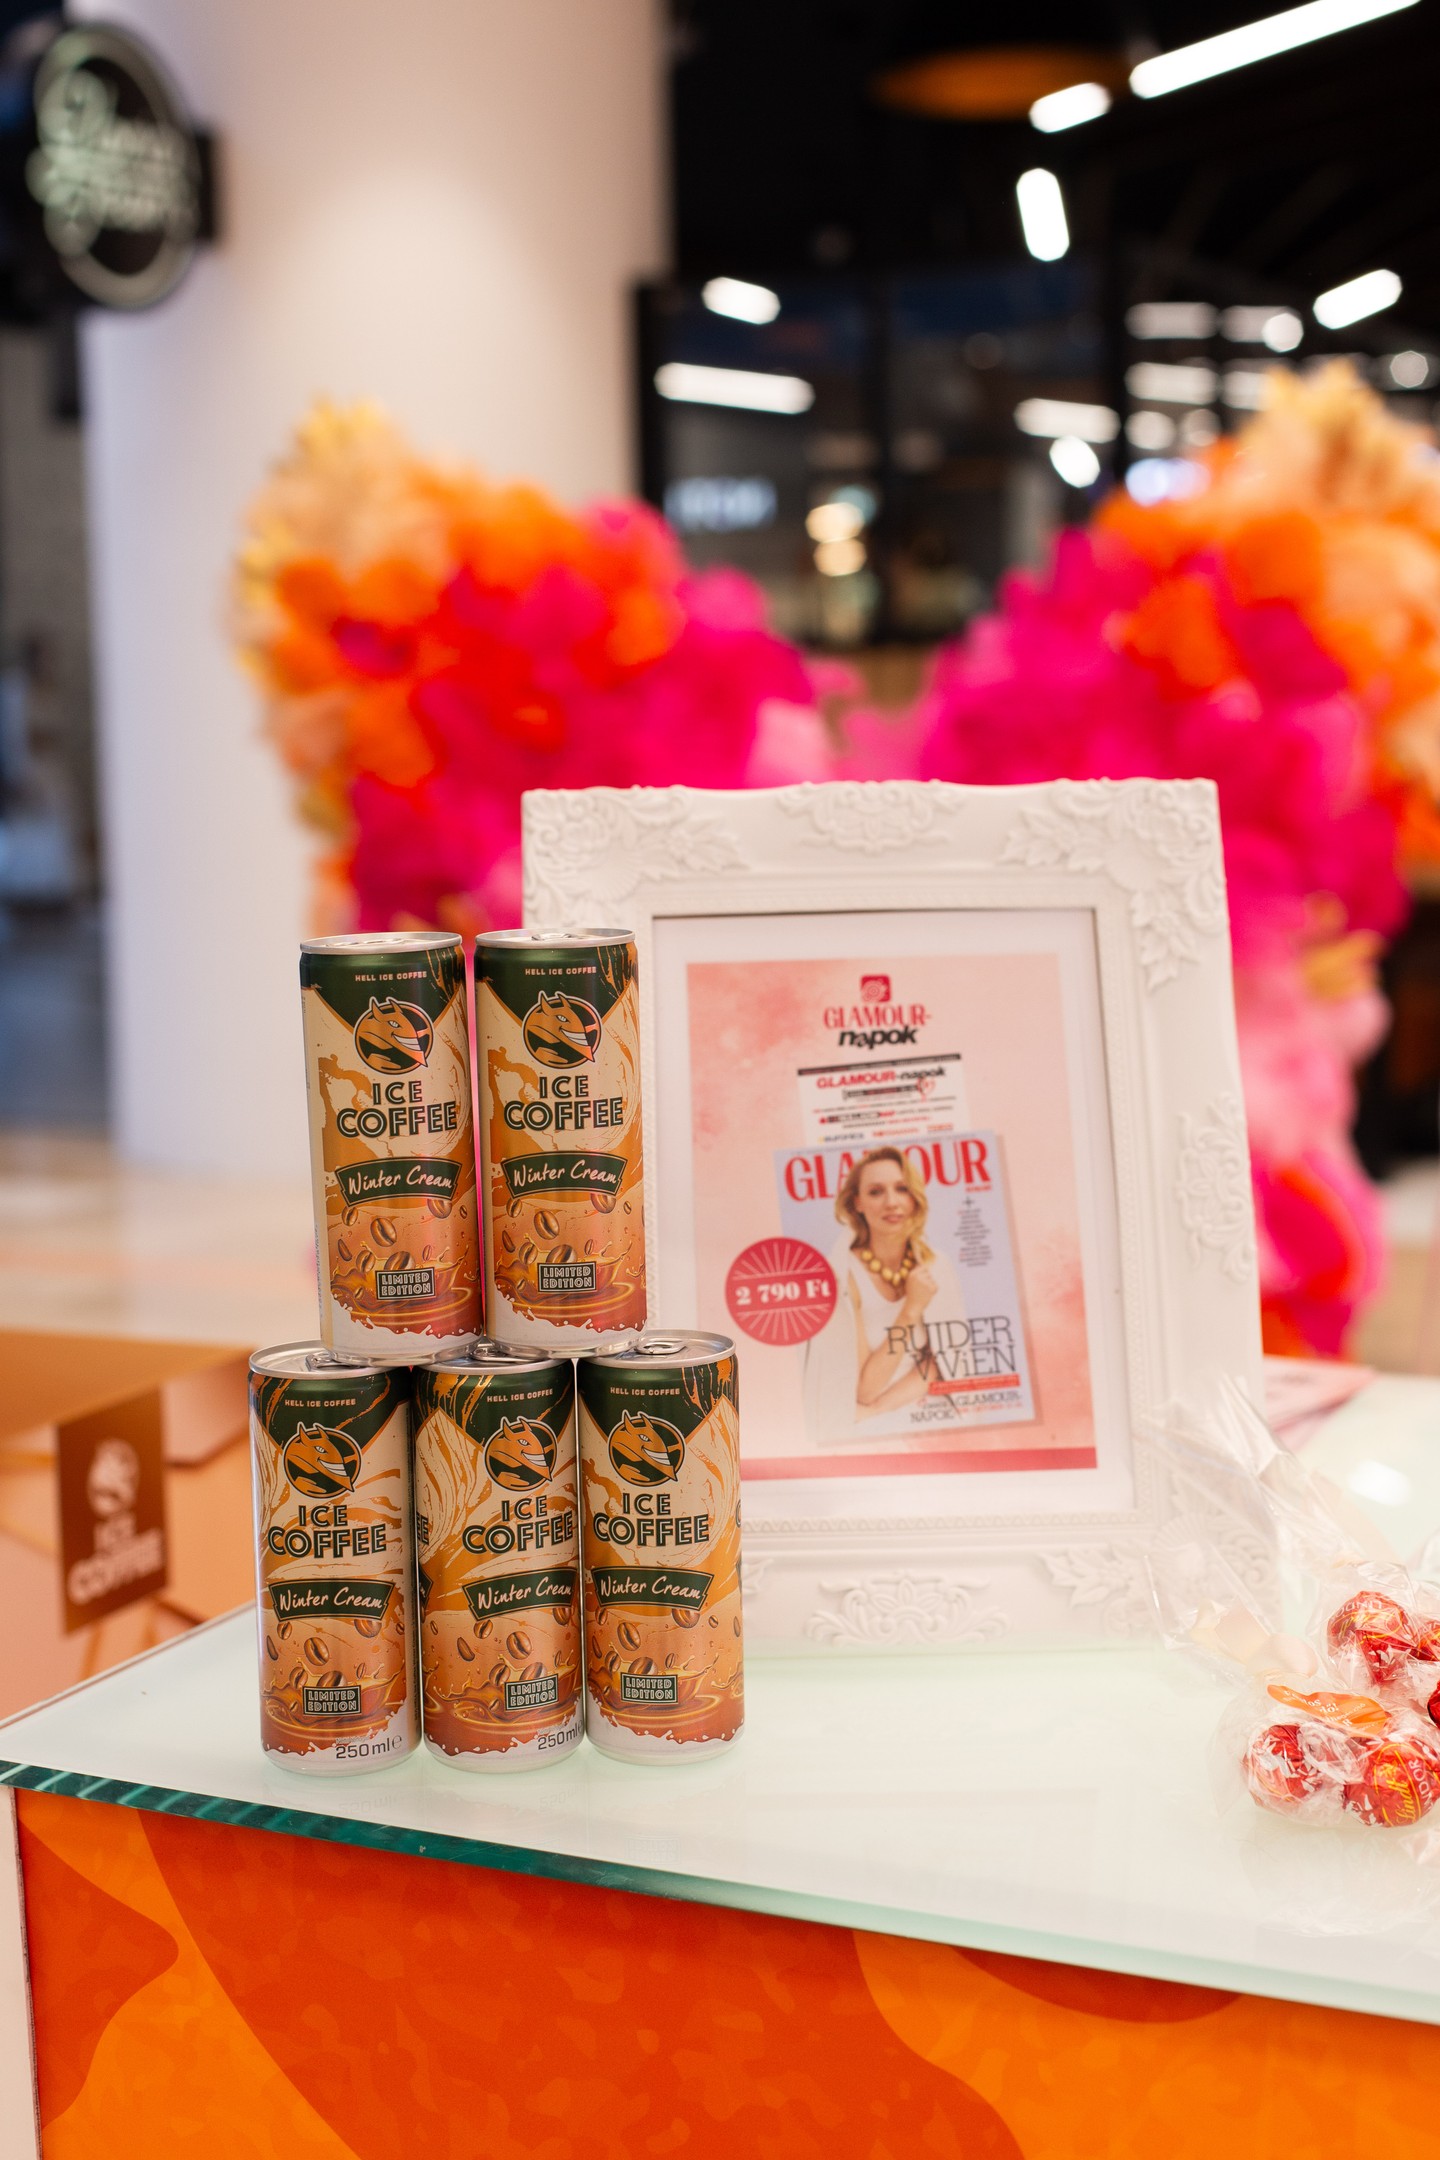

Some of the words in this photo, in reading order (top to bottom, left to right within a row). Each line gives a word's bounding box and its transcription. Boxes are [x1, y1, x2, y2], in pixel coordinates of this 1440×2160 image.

[355, 974, 376, 982] HELL
[379, 973, 394, 981] ICE
[397, 971, 427, 980] COFFEE
[525, 968, 546, 976] HELL
[549, 967, 563, 976] ICE
[566, 966, 597, 975] COFFEE
[838, 1025, 918, 1050] napok
[372, 1081, 423, 1105] ICE
[539, 1075, 589, 1099] ICE
[336, 1101, 458, 1138] COFFEE
[504, 1097, 624, 1131] COFFEE
[348, 1170, 401, 1195] Winter
[406, 1165, 452, 1189] Cream
[513, 1163, 565, 1187] Winter
[570, 1159, 617, 1184] Cream
[784, 1138, 991, 1202] GLAOUR
[381, 1272, 430, 1284] LIMITED
[543, 1266, 591, 1277] LIMITED
[543, 1277, 592, 1288] EDITION
[381, 1283, 431, 1296] EDITION
[735, 1287, 751, 1306] 2
[757, 1281, 800, 1304] 790
[806, 1278, 831, 1299] Ft
[511, 1393, 525, 1401] ICE
[527, 1389, 553, 1400] COFFEE
[610, 1387, 629, 1395] HELL
[632, 1388, 646, 1396] ICE
[648, 1388, 681, 1396] COFFEE
[285, 1399, 304, 1407] HELL
[307, 1400, 321, 1408] ICE
[324, 1399, 356, 1407] COFFEE
[501, 1495, 547, 1522] ICE
[622, 1493, 671, 1515] ICE
[298, 1505, 348, 1527] ICE
[462, 1511, 573, 1554] COFFEE
[593, 1513, 709, 1547] COFFEE
[268, 1524, 387, 1559] COFFEE
[477, 1584, 531, 1610] Winter
[535, 1576, 572, 1598] Cream
[600, 1575, 647, 1597] Winter
[651, 1575, 701, 1599] Cream
[279, 1589, 329, 1611] Winter
[334, 1586, 383, 1609] Cream
[511, 1678, 555, 1696] LIMITED
[625, 1688, 673, 1700] EDITION
[626, 1677, 672, 1689] LIMITED
[308, 1689, 356, 1701] LIMITED
[510, 1691, 556, 1707] EDITION
[308, 1701, 357, 1712] EDITION
[336, 1744, 369, 1759] 250
